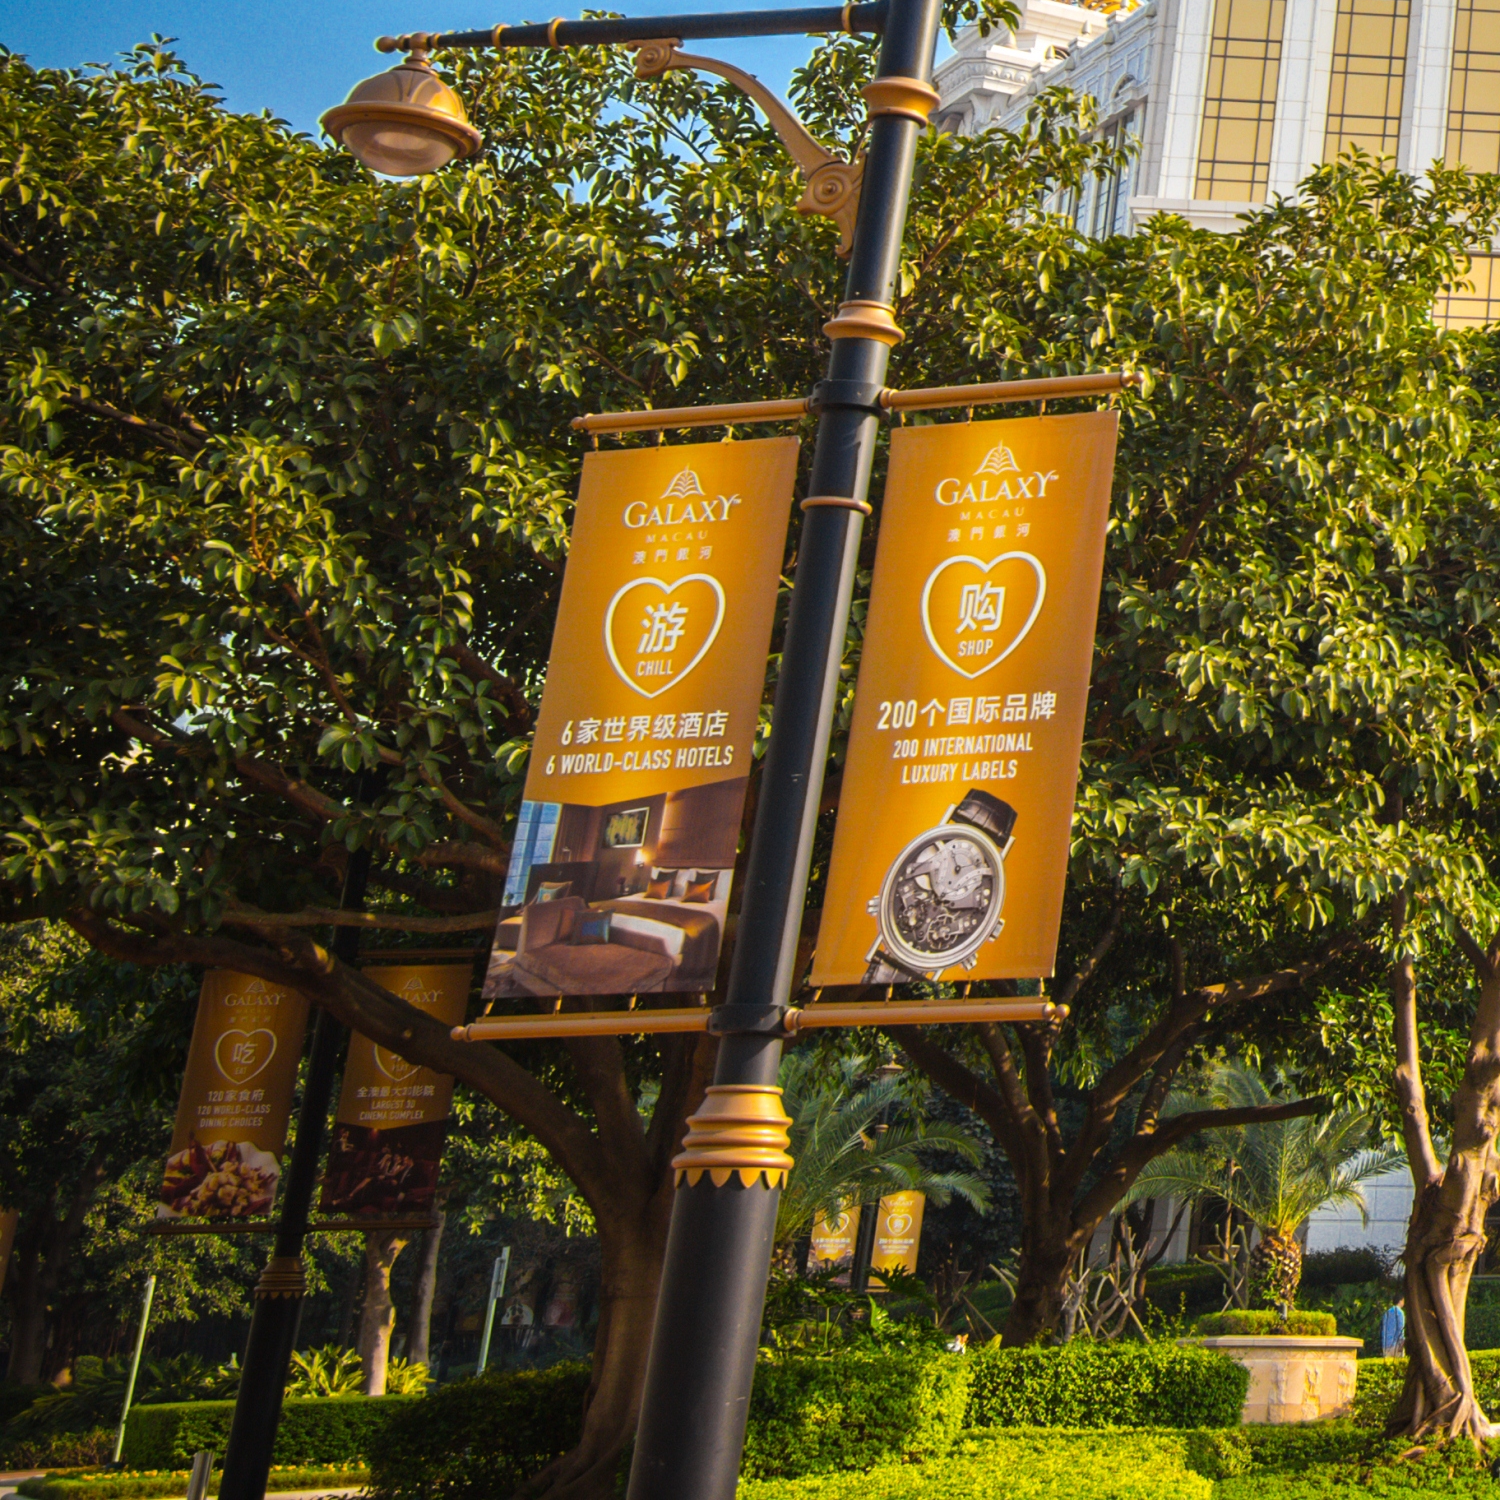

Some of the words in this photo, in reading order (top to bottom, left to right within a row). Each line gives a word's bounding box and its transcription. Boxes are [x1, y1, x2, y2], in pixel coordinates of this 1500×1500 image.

[934, 470, 1058, 506] GALAXY
[622, 493, 740, 528] GALAXY
[959, 507, 1025, 521] MACAU
[645, 530, 709, 544] MACAU
[947, 522, 1031, 543] 澳門銀河
[632, 545, 713, 565] 澳門銀河
[955, 580, 1006, 635] 购
[636, 601, 689, 654] 游
[957, 638, 994, 657] SHOP
[635, 659, 674, 677] CHILL
[892, 738, 919, 760] 200
[923, 732, 1034, 758] INTERNATIONAL
[545, 754, 557, 775] 6
[560, 749, 672, 775] WORLD-CLASS
[675, 745, 735, 769] HOTELS
[901, 762, 959, 784] LUXURY
[961, 759, 1019, 782] LABELS
[232, 1040, 259, 1065] 吃
[197, 1105, 212, 1116] 120
